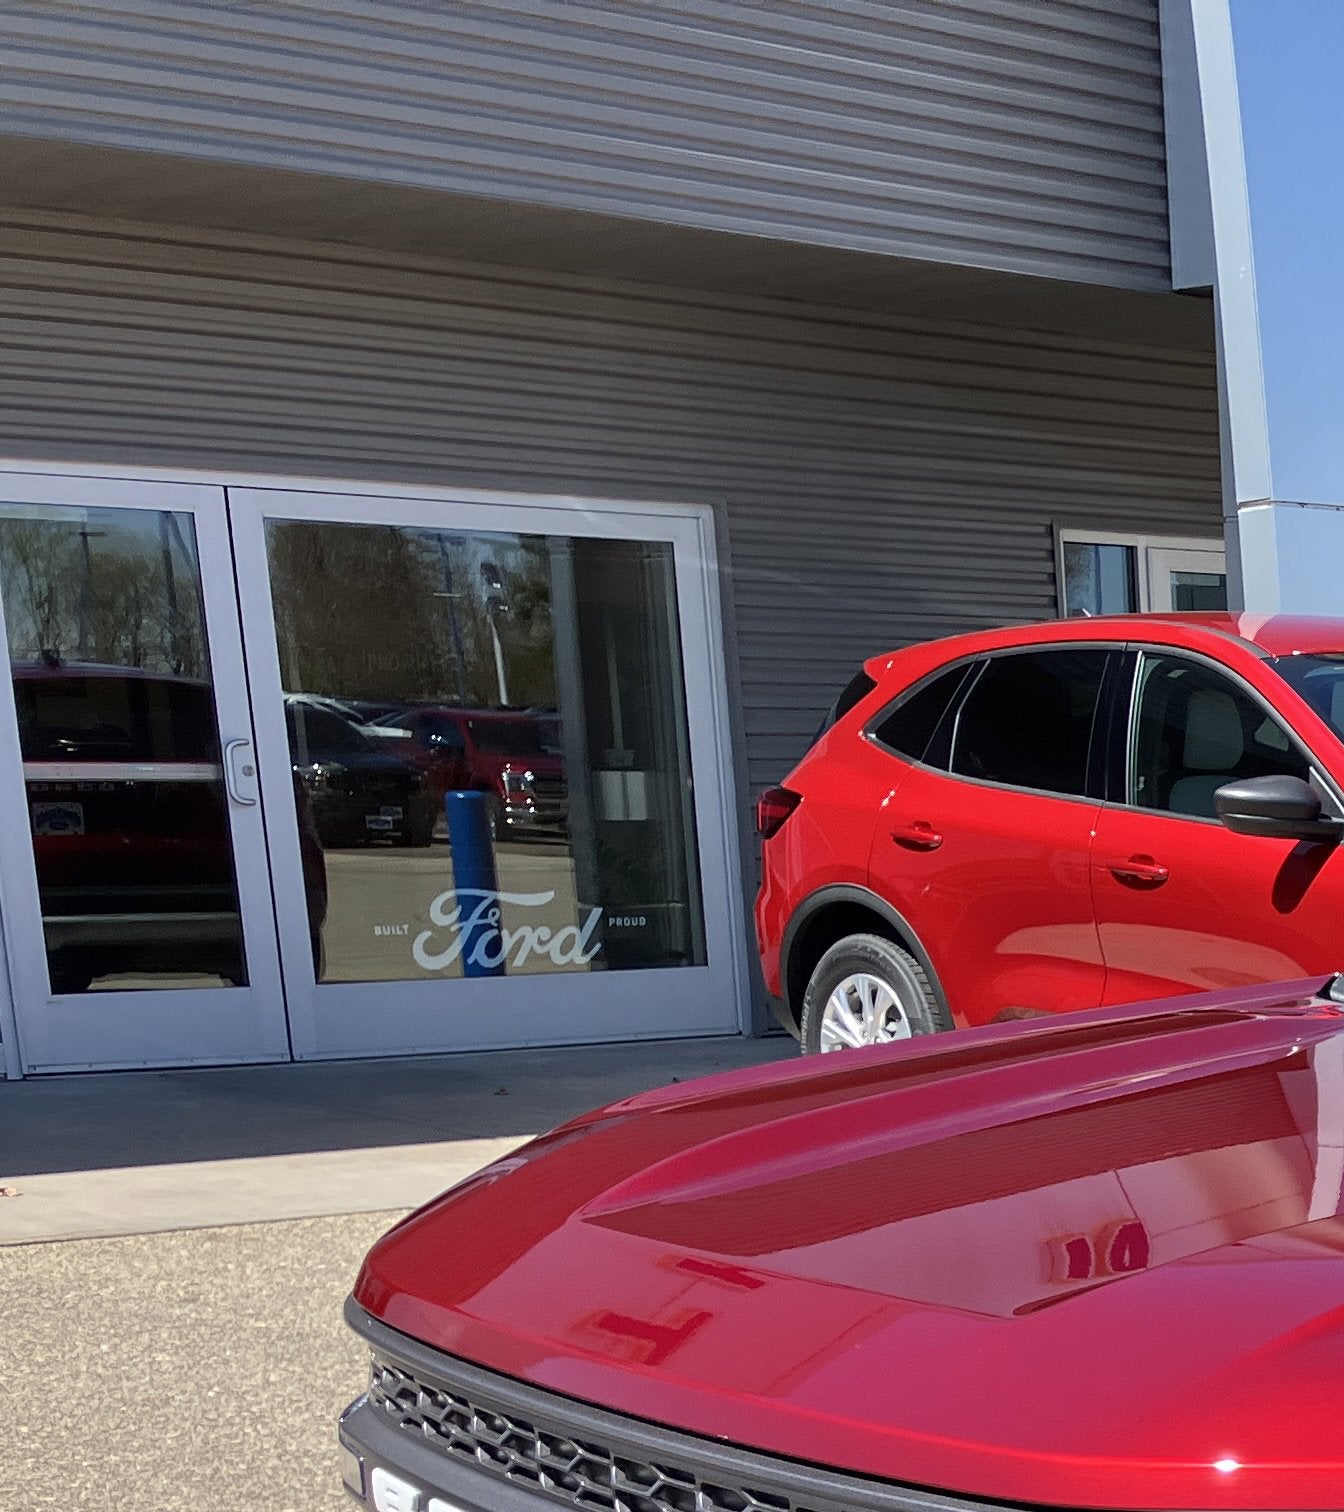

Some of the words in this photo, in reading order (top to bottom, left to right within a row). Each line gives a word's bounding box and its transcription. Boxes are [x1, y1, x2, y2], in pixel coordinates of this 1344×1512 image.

[374, 923, 409, 937] BUILT
[411, 888, 604, 971] Ford
[608, 916, 647, 928] PROUD
